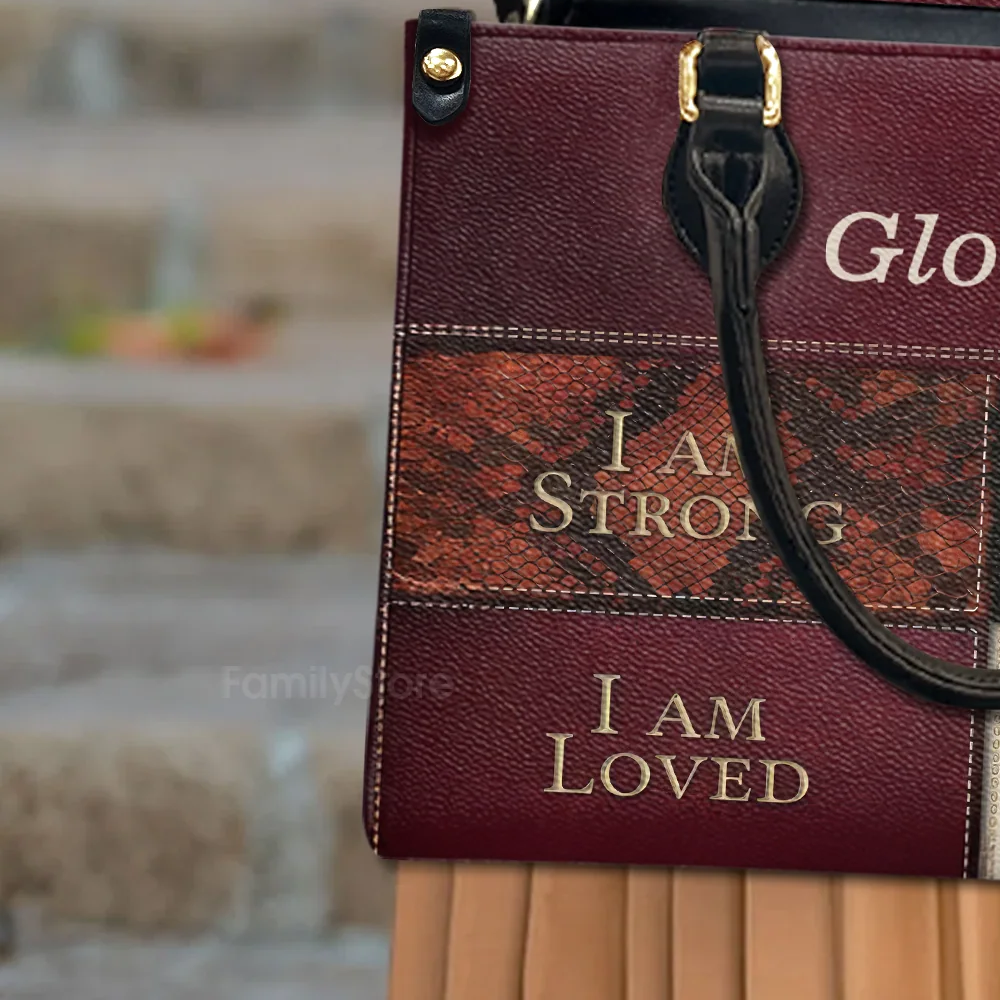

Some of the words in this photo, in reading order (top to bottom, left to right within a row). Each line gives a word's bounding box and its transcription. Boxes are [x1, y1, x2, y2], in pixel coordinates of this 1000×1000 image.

[601, 409, 633, 473] I
[590, 673, 621, 735] I
[645, 693, 767, 742] AM
[543, 732, 810, 804] LOVED
